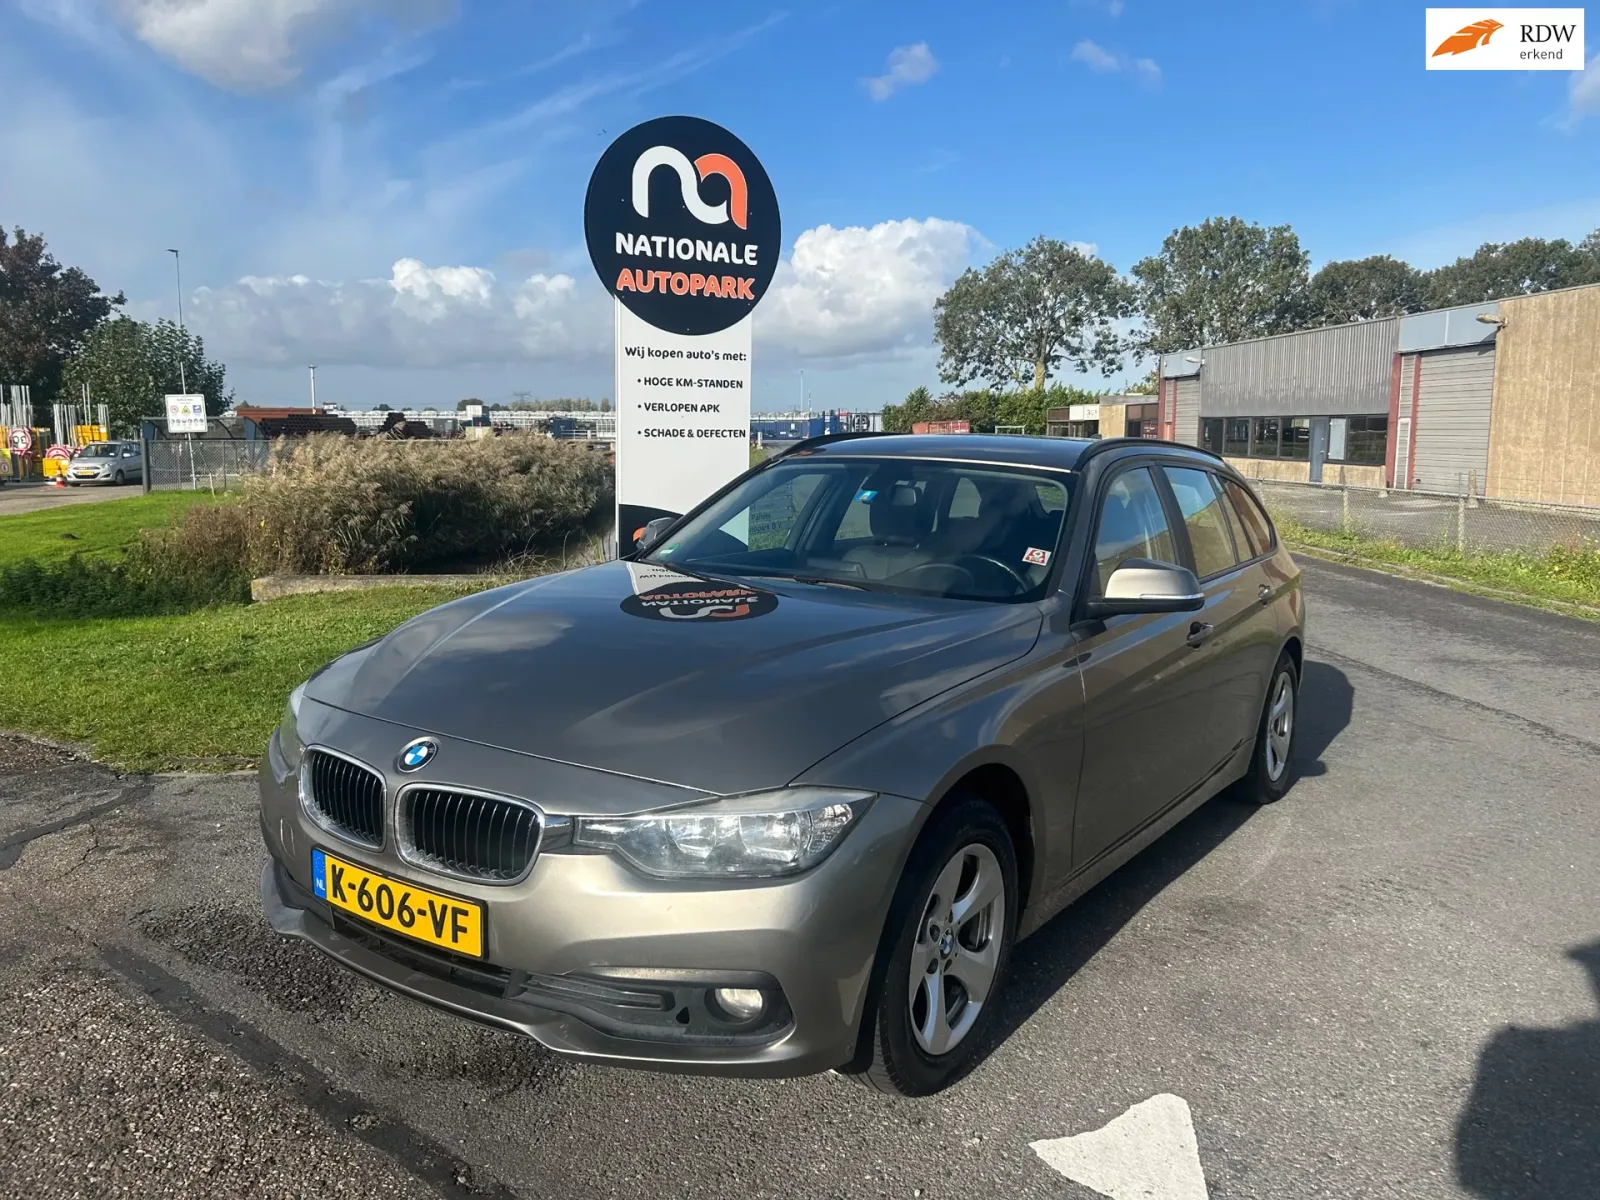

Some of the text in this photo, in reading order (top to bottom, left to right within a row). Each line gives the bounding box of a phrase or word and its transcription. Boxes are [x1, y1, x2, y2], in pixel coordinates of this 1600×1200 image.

[615, 232, 759, 266] NATIONALE
[616, 268, 756, 300] AUTOPARK
[625, 346, 747, 361] Wij kopen auto's met:
[643, 377, 743, 389] HOGE KM-STANDEN
[644, 402, 720, 413] VERLOPEN APK
[644, 428, 746, 438] SCHADE & DEFECTEN
[316, 877, 325, 891] NL
[331, 863, 469, 943] K-606-VF
